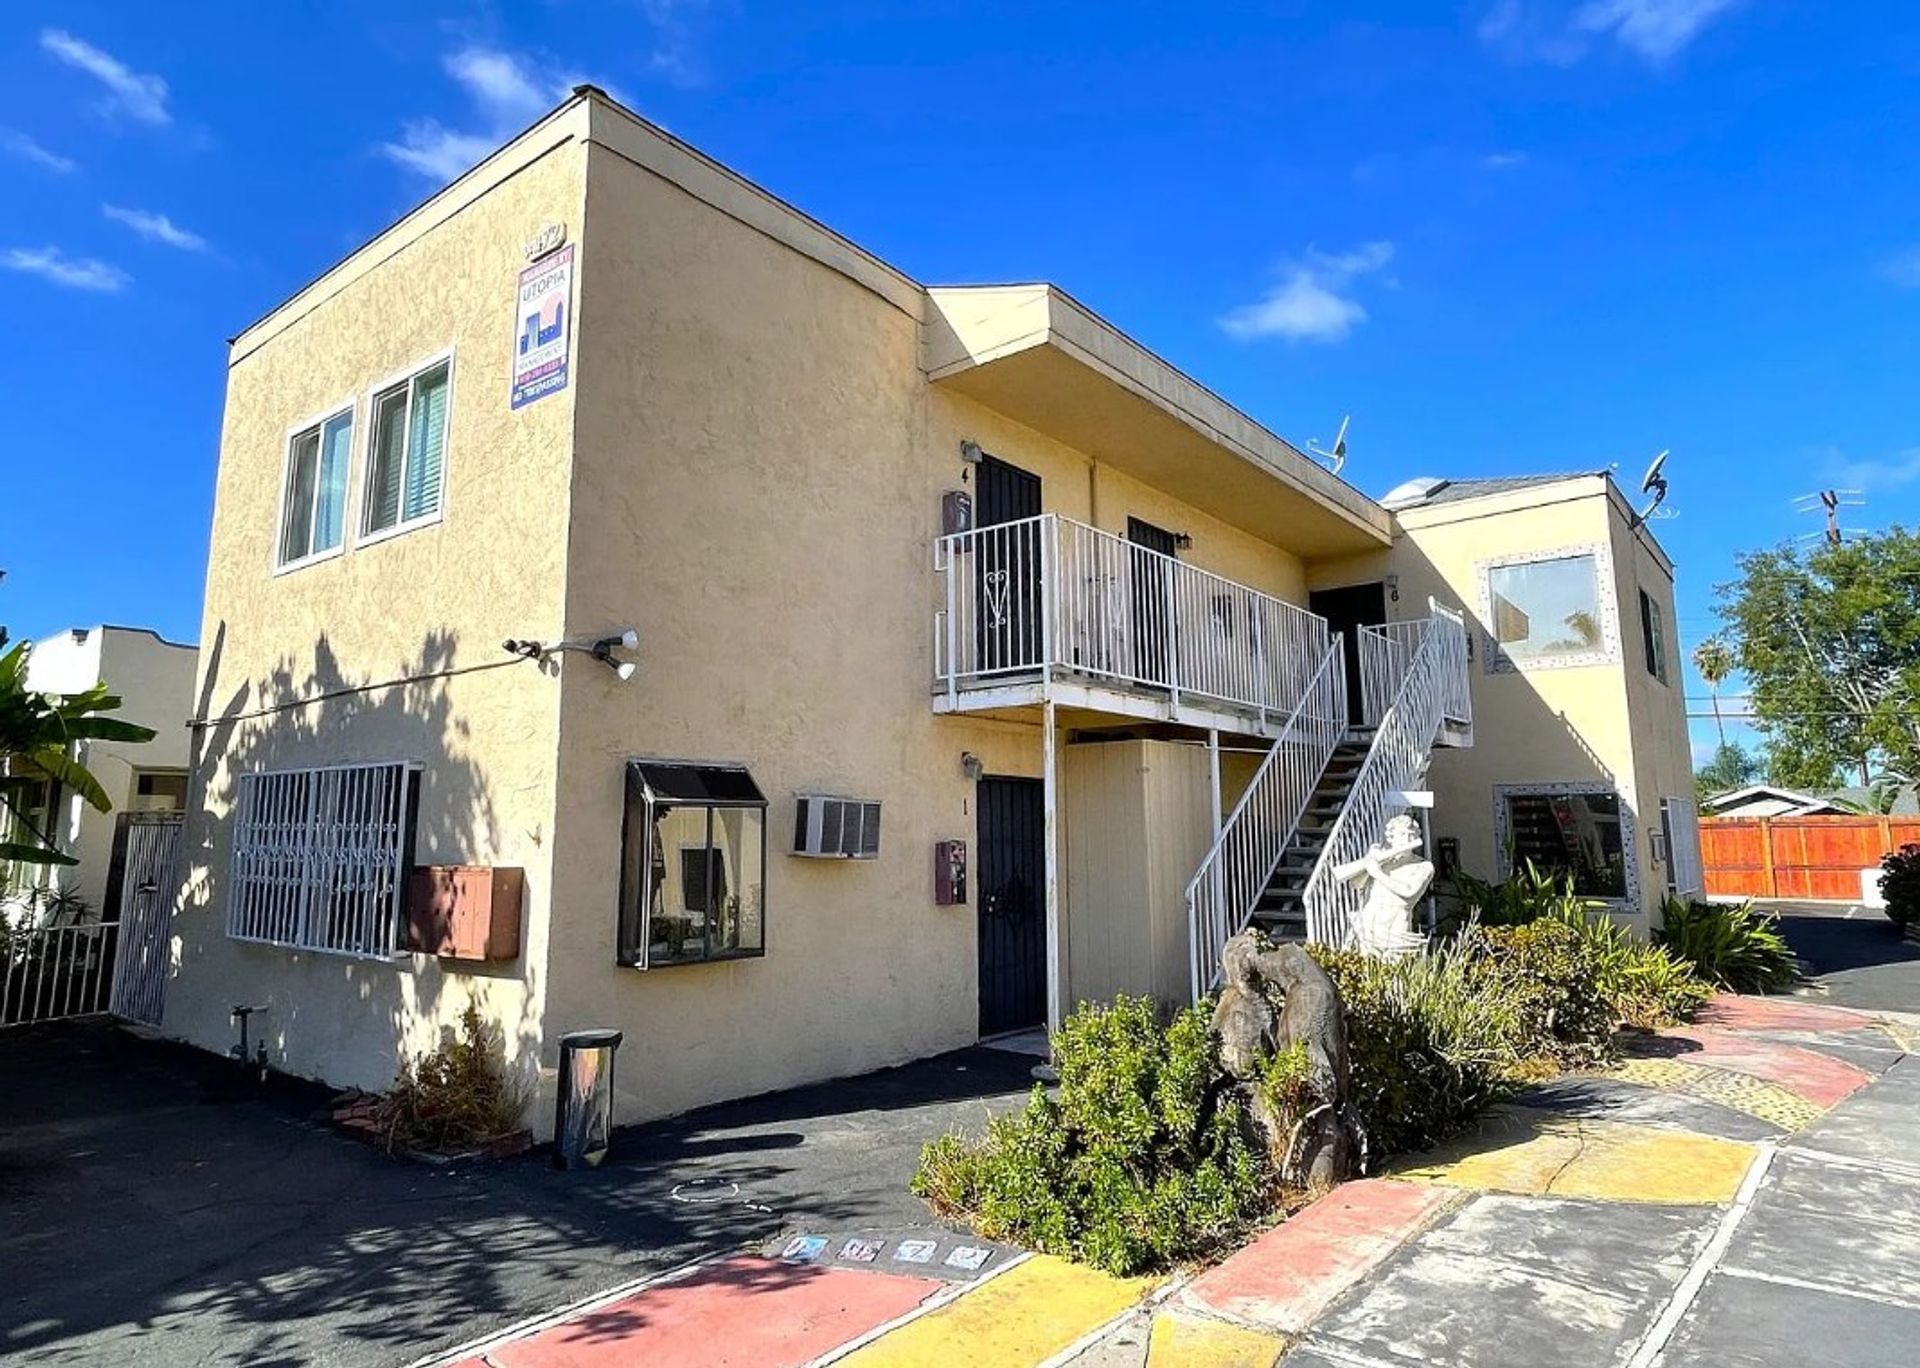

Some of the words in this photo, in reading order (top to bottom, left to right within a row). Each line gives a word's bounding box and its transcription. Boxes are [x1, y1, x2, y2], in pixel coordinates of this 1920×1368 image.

[522, 269, 566, 302] UTOPIA
[961, 467, 969, 484] 4
[1391, 590, 1399, 602] 6
[963, 798, 968, 815] 1
